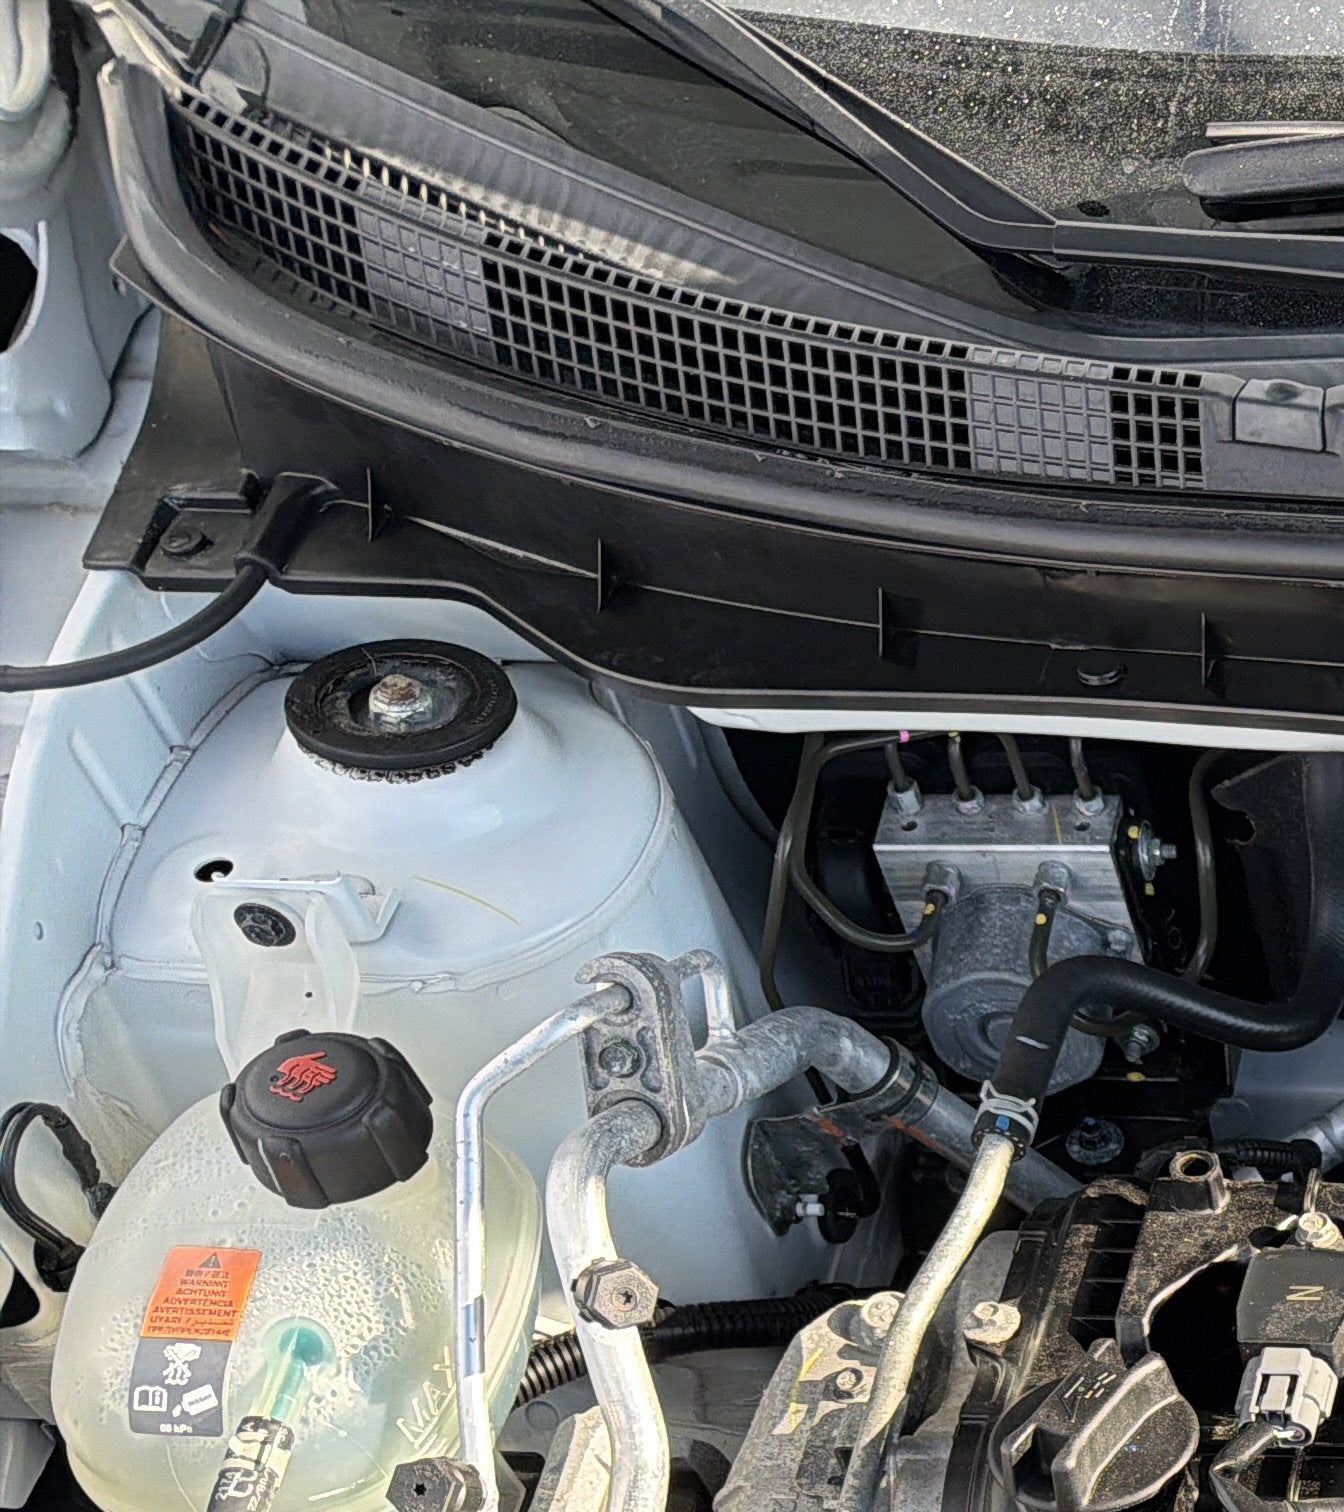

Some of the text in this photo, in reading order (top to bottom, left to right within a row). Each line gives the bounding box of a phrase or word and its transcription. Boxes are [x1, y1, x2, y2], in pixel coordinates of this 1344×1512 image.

[180, 1279, 229, 1288] WARNING
[162, 1297, 234, 1307] ADVERTENCIA
[151, 1306, 239, 1317] AVERTISSEMENT
